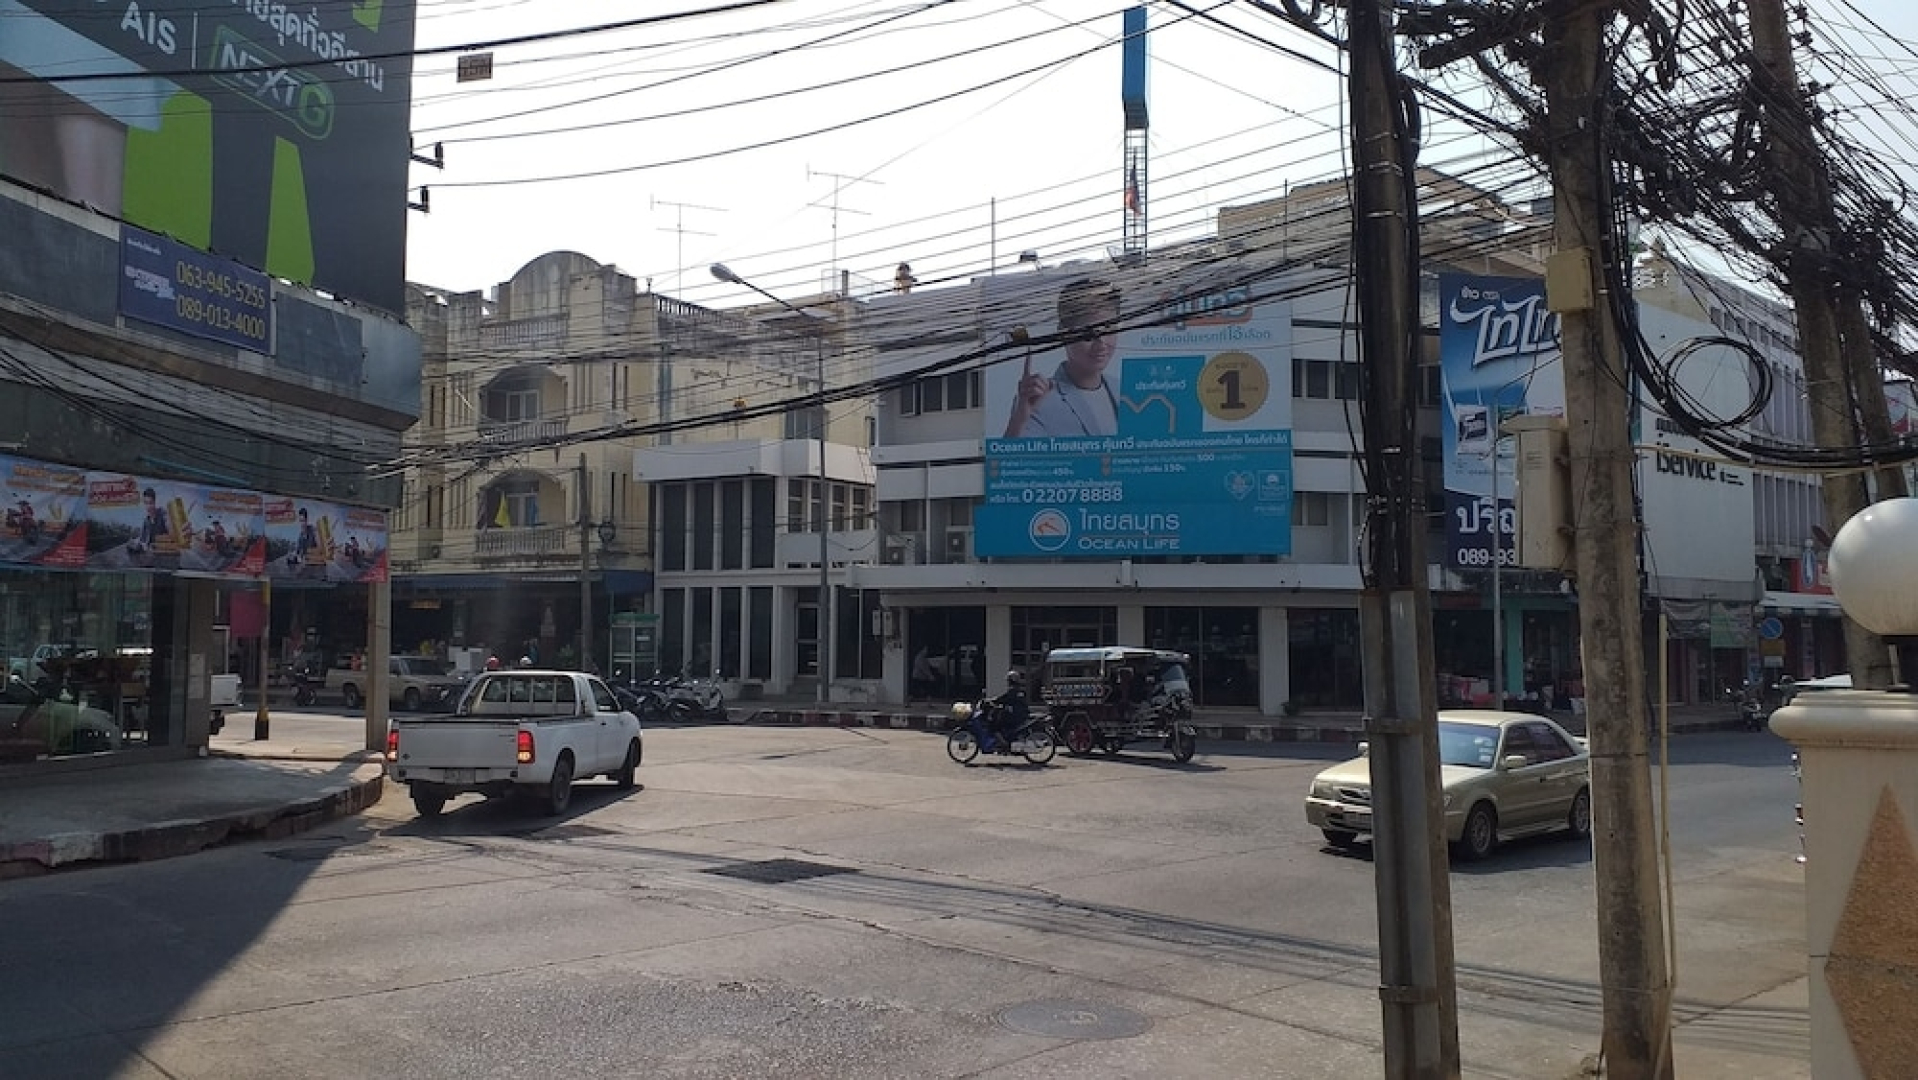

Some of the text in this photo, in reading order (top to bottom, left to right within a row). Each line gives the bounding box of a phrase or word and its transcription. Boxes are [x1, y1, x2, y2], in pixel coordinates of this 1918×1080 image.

[120, 1, 177, 55] AIS
[176, 260, 266, 310] 063-945-5255
[176, 294, 266, 341] 089-013-4000
[1218, 369, 1246, 410] 1
[989, 440, 1025, 453] Ocean
[1027, 439, 1048, 452] Life
[1656, 441, 1717, 481] iService
[1079, 508, 1180, 536] ไทยสมุทร
[1078, 537, 1180, 550] OCEAN LIFE
